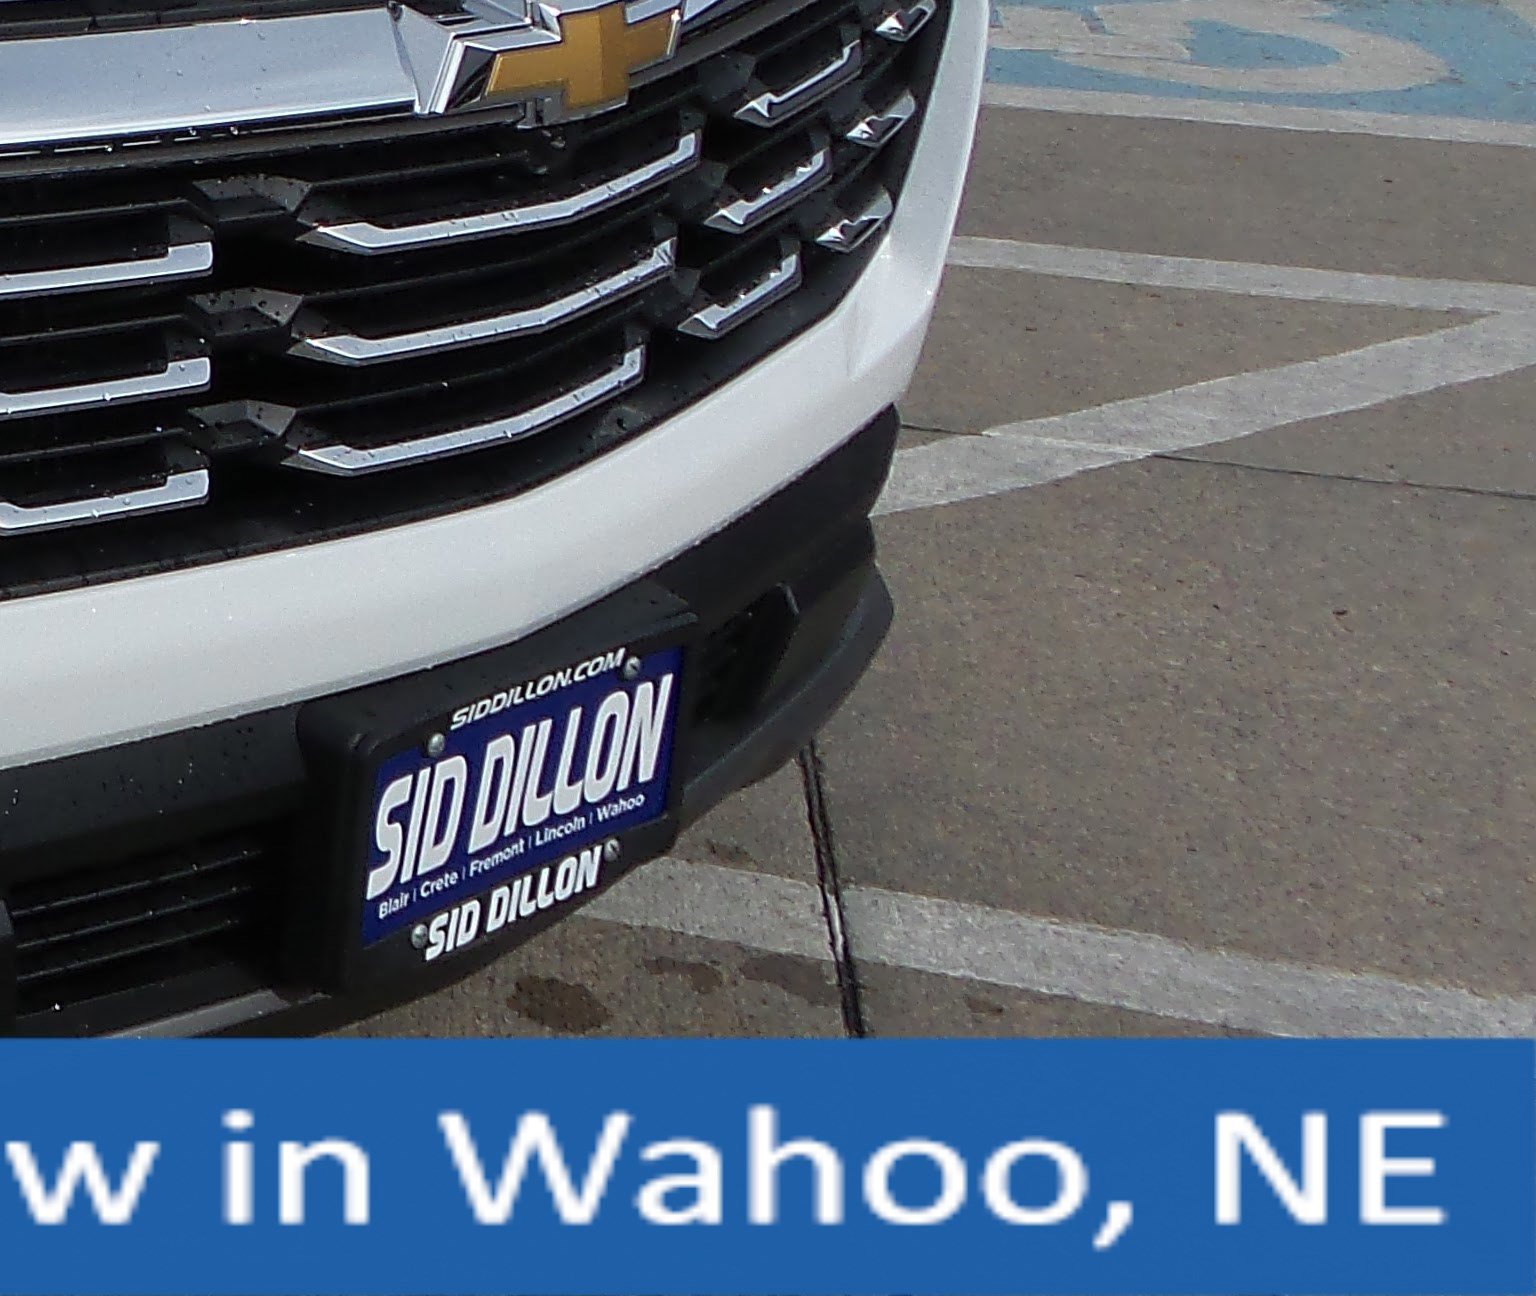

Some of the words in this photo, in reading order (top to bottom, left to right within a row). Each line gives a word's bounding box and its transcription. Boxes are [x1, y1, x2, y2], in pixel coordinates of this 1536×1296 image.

[450, 647, 626, 731] SIDDILLON.COM
[366, 755, 468, 901] SID
[468, 673, 674, 855] DILLON
[378, 891, 410, 919] Blair
[420, 870, 459, 898] Crete
[469, 838, 526, 877] Fremont
[535, 815, 586, 847] Lincoln
[597, 793, 645, 824] Wahoo
[425, 899, 480, 962] SID
[486, 844, 604, 933] DILLON
